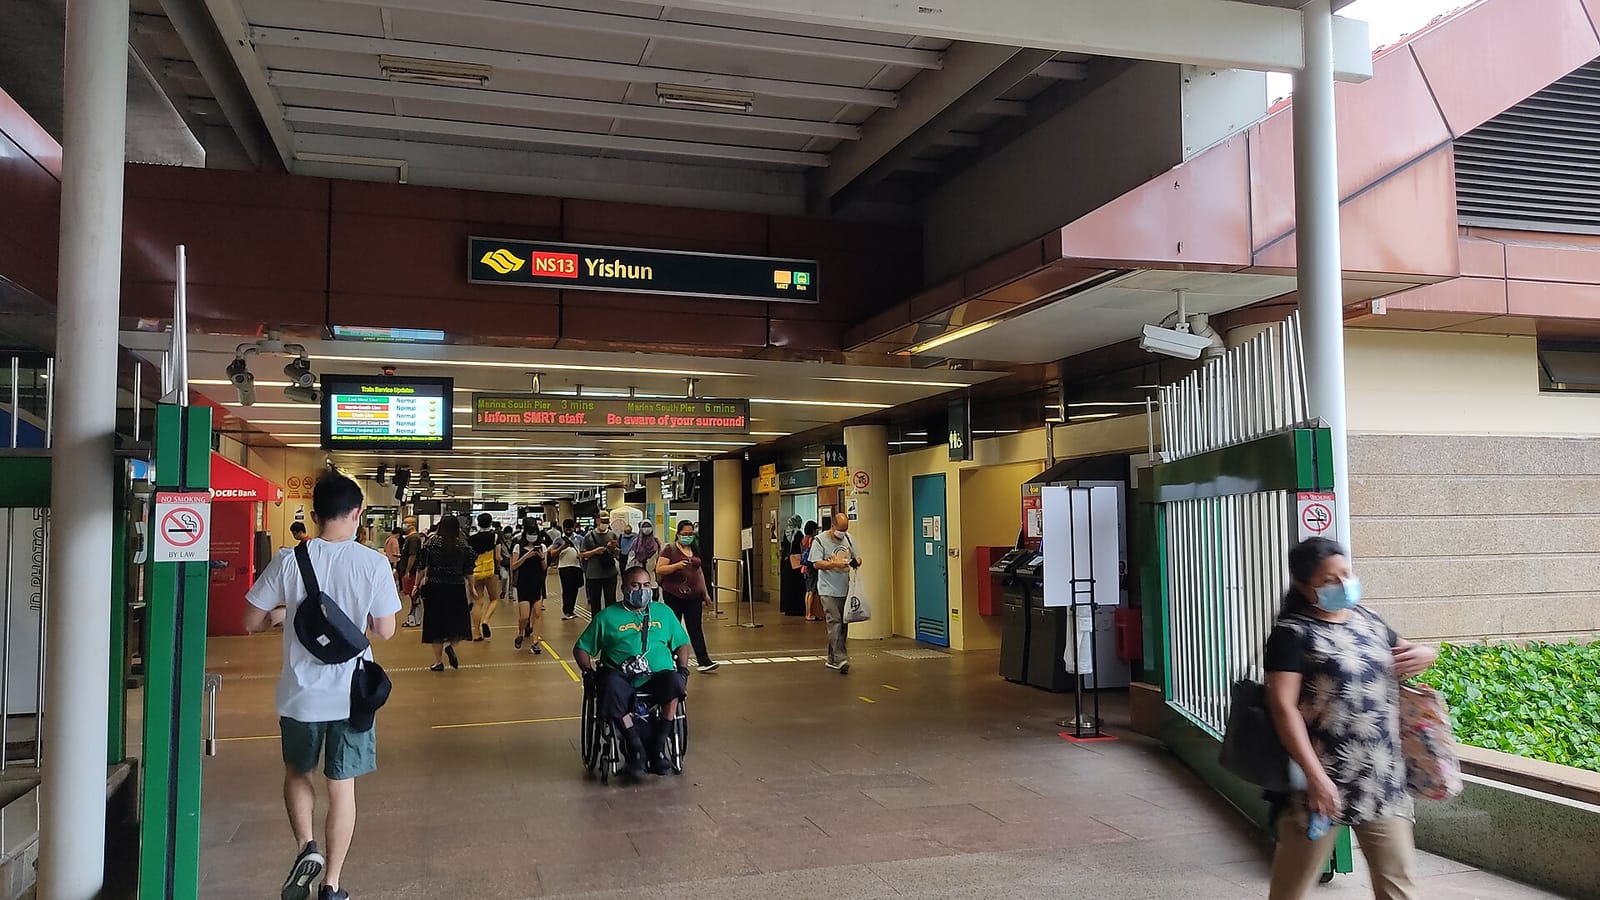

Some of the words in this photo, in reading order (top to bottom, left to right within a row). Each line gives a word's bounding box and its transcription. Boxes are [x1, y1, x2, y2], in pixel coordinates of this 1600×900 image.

[536, 257, 575, 273] NS13
[584, 257, 653, 280] Yishun
[478, 400, 506, 409] Marina
[508, 400, 532, 409] South
[534, 401, 552, 410] Pier
[561, 400, 568, 410] 3
[571, 400, 594, 410] mins
[628, 402, 654, 412] Marina
[655, 403, 678, 412] South
[680, 403, 696, 413] Pier
[705, 403, 711, 413] 6
[713, 403, 736, 413] mins
[523, 412, 557, 424] SMRT
[558, 412, 588, 424] staff.
[607, 413, 622, 425] Be
[623, 415, 656, 426] aware
[657, 414, 670, 426] of
[670, 416, 695, 428] your
[696, 416, 745, 427] surroundi
[215, 489, 238, 497] OCBC
[238, 489, 257, 497] Bank
[161, 496, 172, 504] NO
[174, 496, 206, 504] SMOKING
